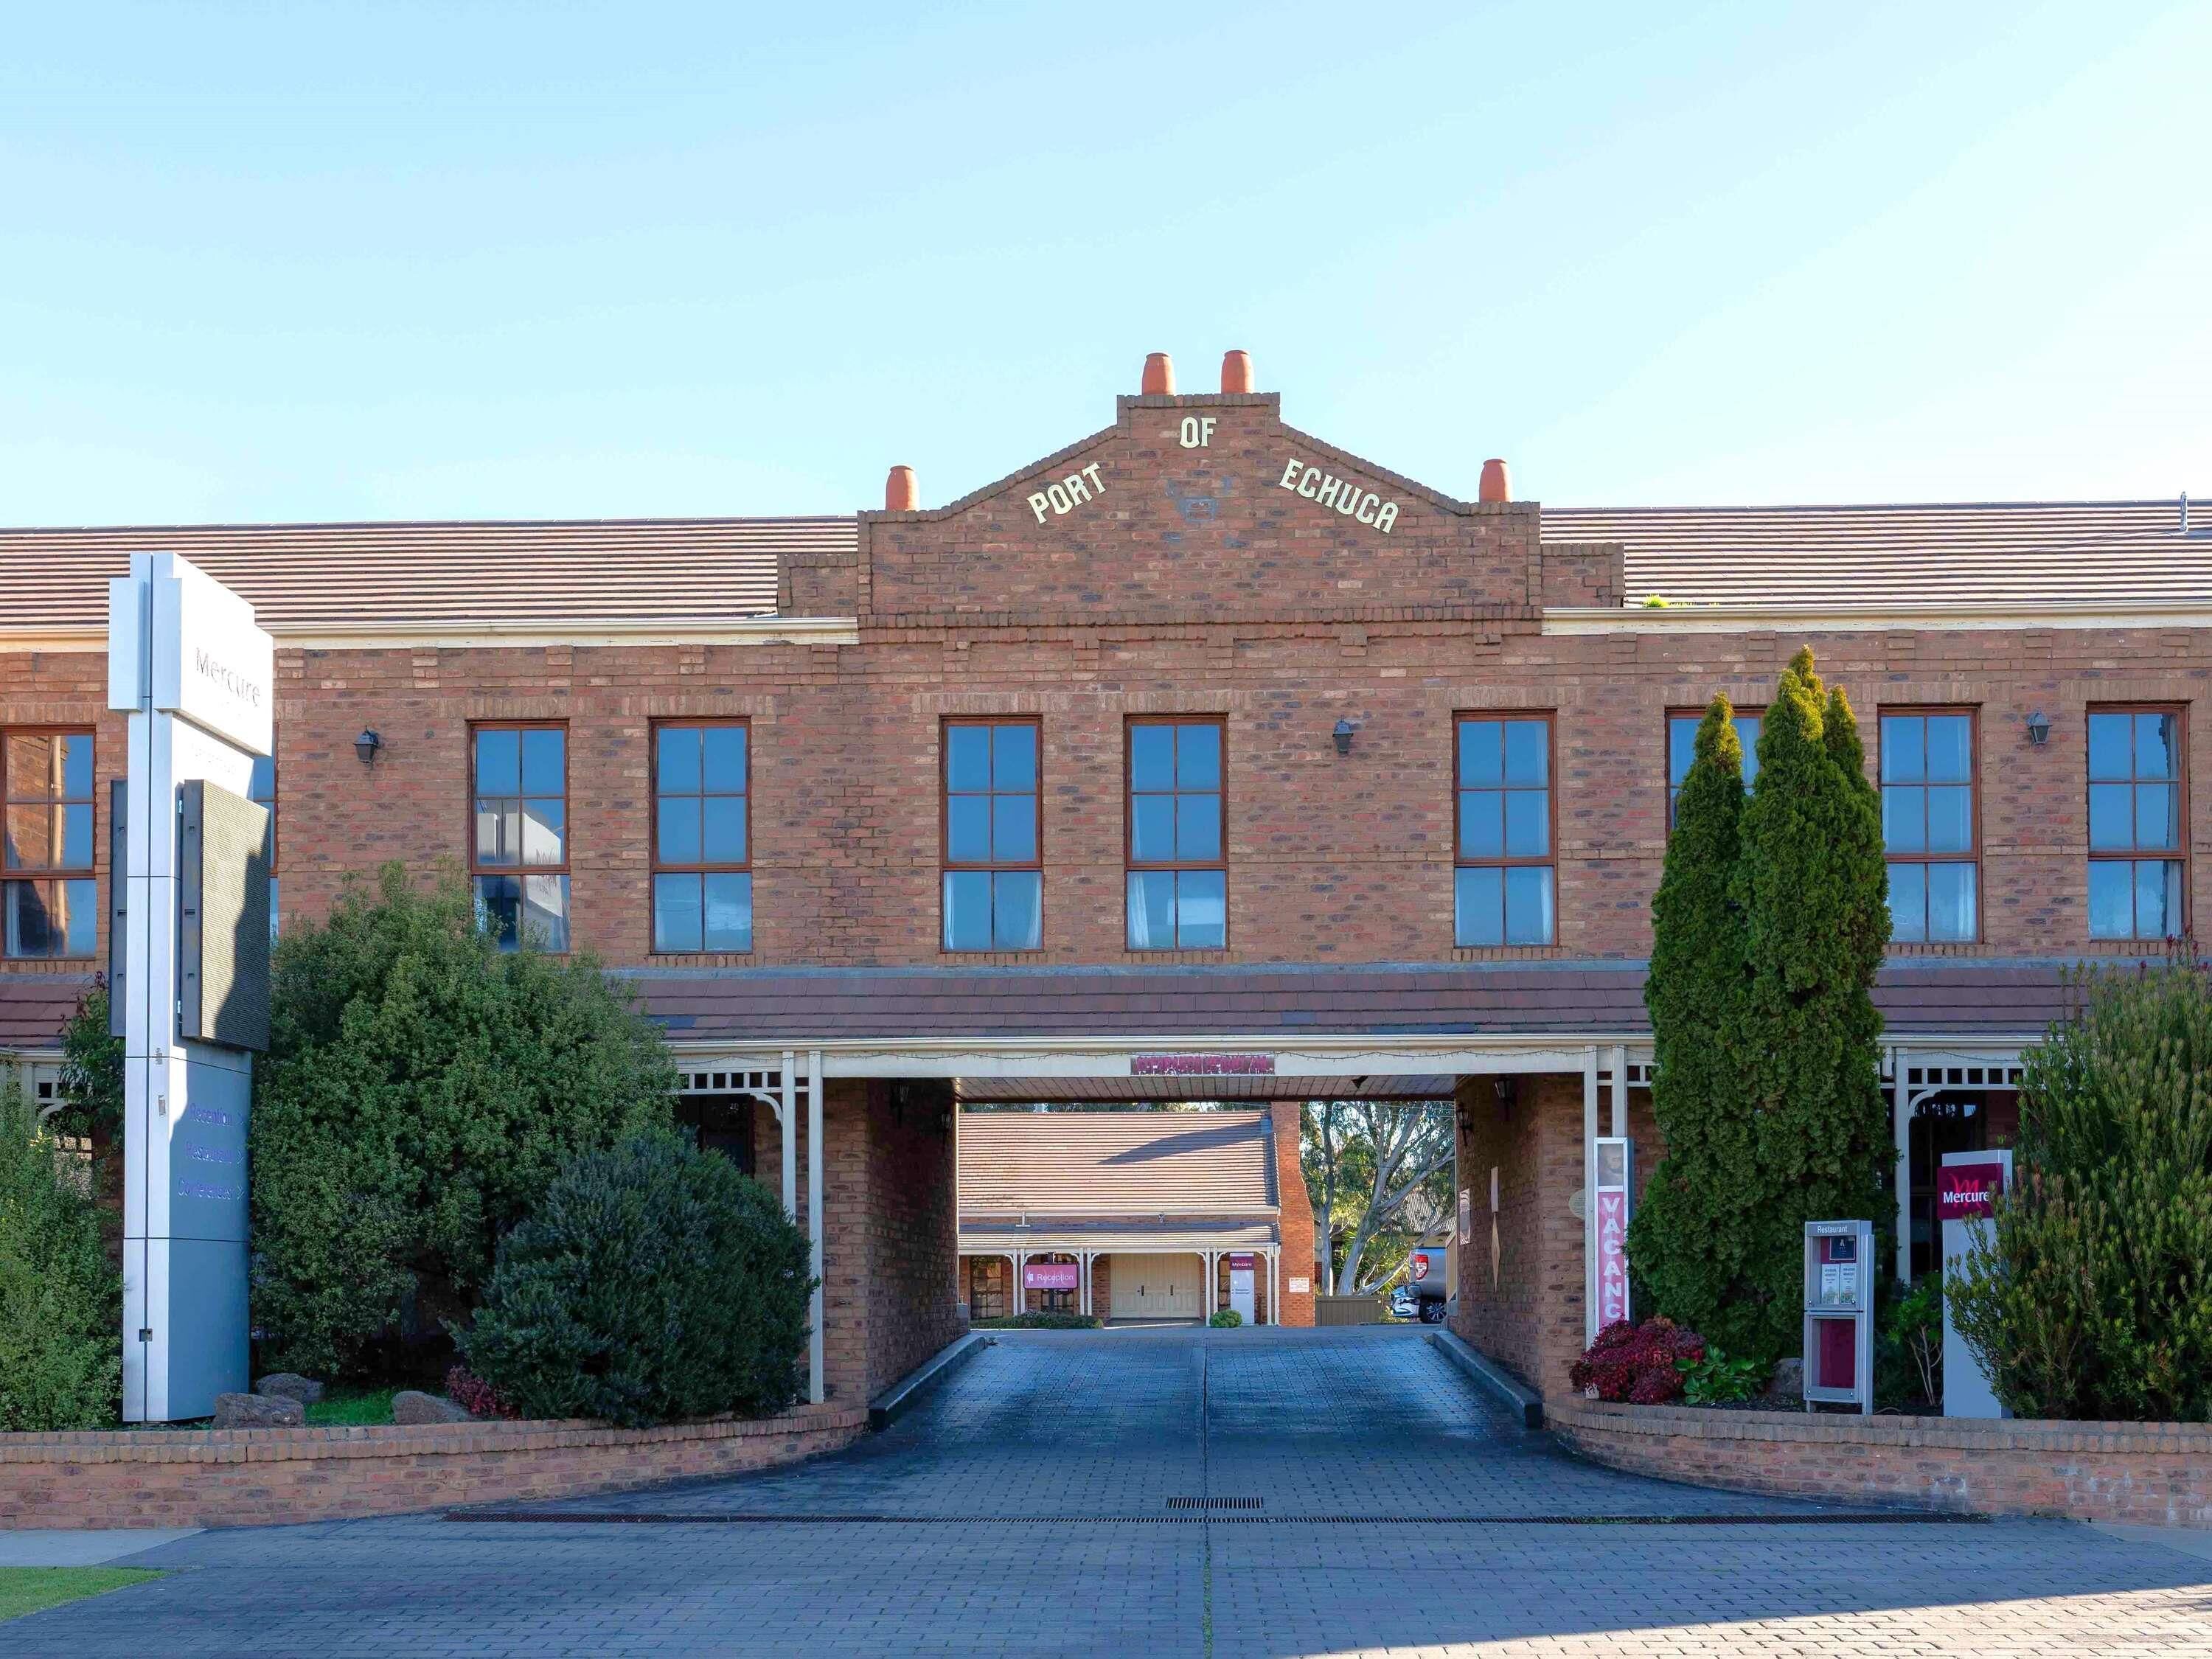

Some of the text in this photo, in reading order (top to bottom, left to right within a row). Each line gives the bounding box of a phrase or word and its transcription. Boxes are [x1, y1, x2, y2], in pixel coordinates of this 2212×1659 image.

[1026, 417, 1399, 534] PORT OF ECHUCA
[195, 647, 260, 708] Mercure
[1942, 1190, 1990, 1204] Mercure
[1817, 1225, 1848, 1234] Restaurant
[1601, 1197, 1622, 1318] VACANC
[1036, 1273, 1074, 1283] Reception
